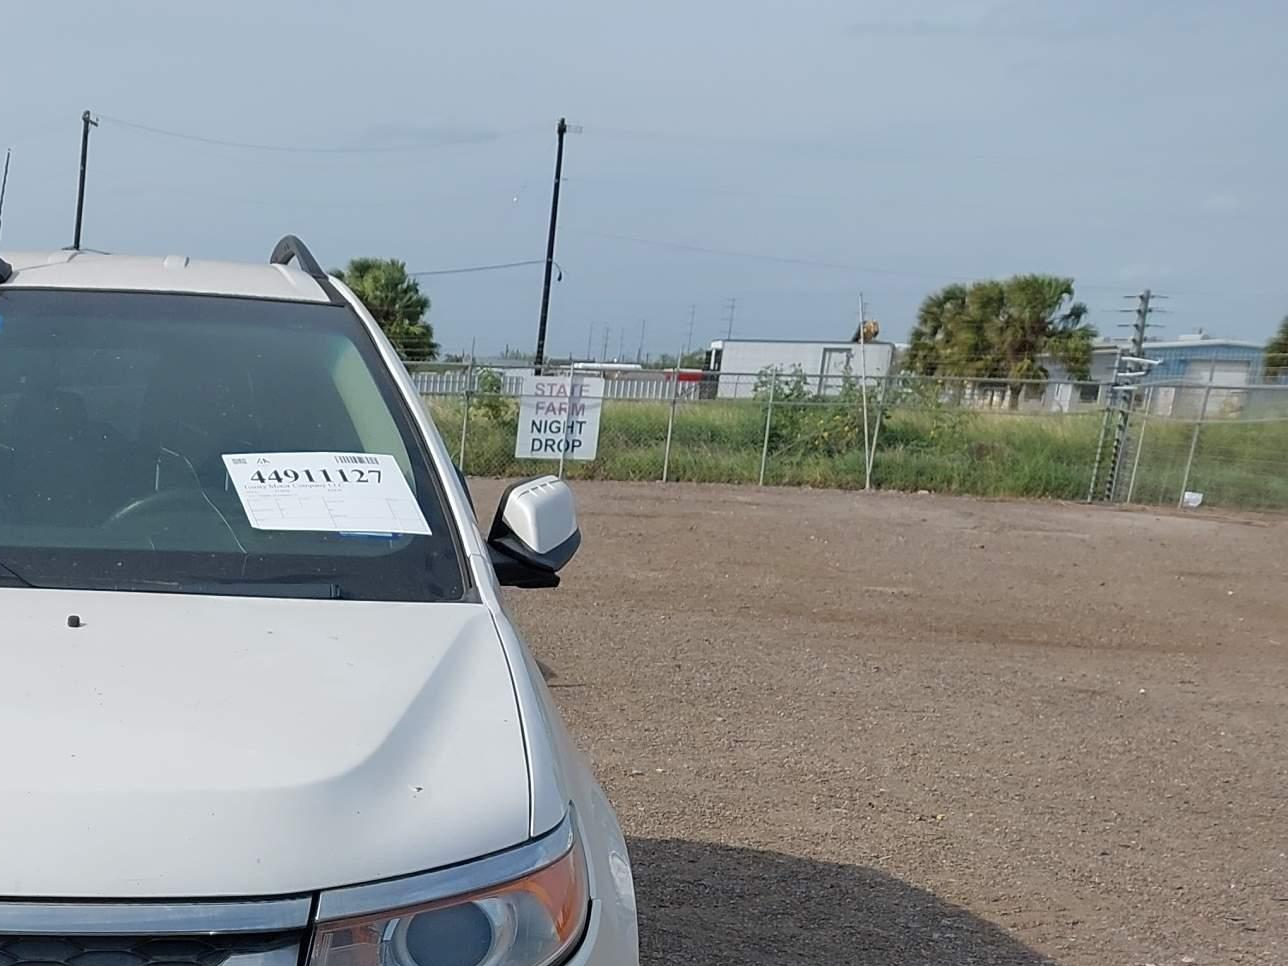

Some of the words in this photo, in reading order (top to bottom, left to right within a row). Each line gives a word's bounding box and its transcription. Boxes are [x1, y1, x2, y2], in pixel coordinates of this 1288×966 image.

[535, 382, 590, 397] STATE
[535, 401, 585, 416] FARM
[530, 420, 587, 435] NIGHT
[531, 438, 582, 453] DROP
[250, 468, 382, 484] 44911127
